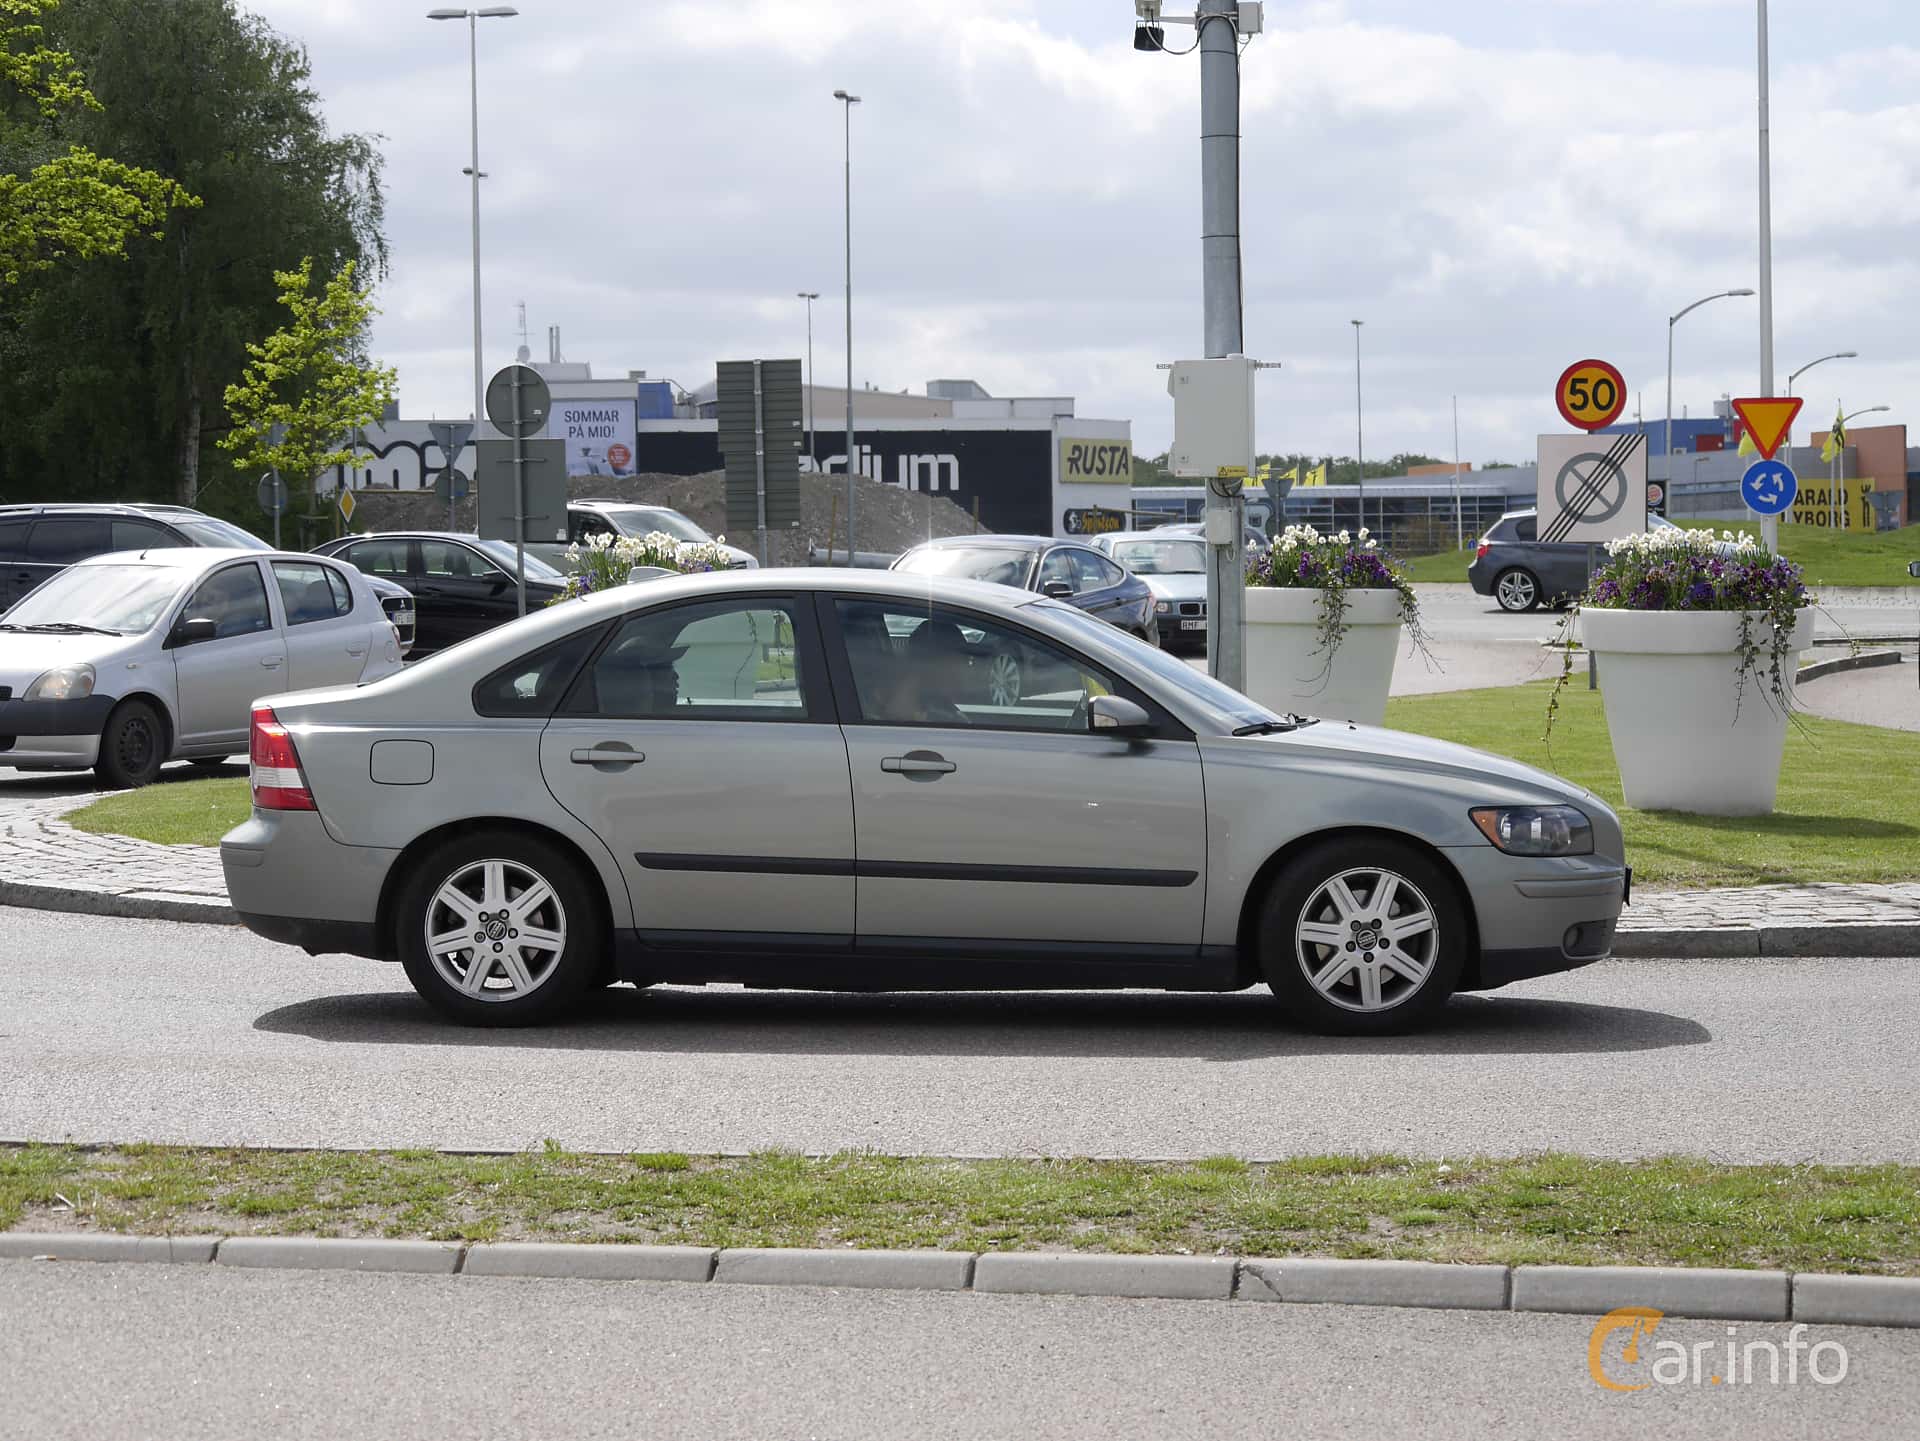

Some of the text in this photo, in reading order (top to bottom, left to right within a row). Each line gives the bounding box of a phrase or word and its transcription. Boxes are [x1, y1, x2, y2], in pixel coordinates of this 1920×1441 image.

[1569, 377, 1616, 411] 50
[564, 410, 620, 423] SOMMAR
[568, 424, 615, 438] PÅ MIO!
[1067, 444, 1129, 476] RUSTA
[1794, 488, 1849, 506] ARALD
[1781, 509, 1851, 528] YBORG
